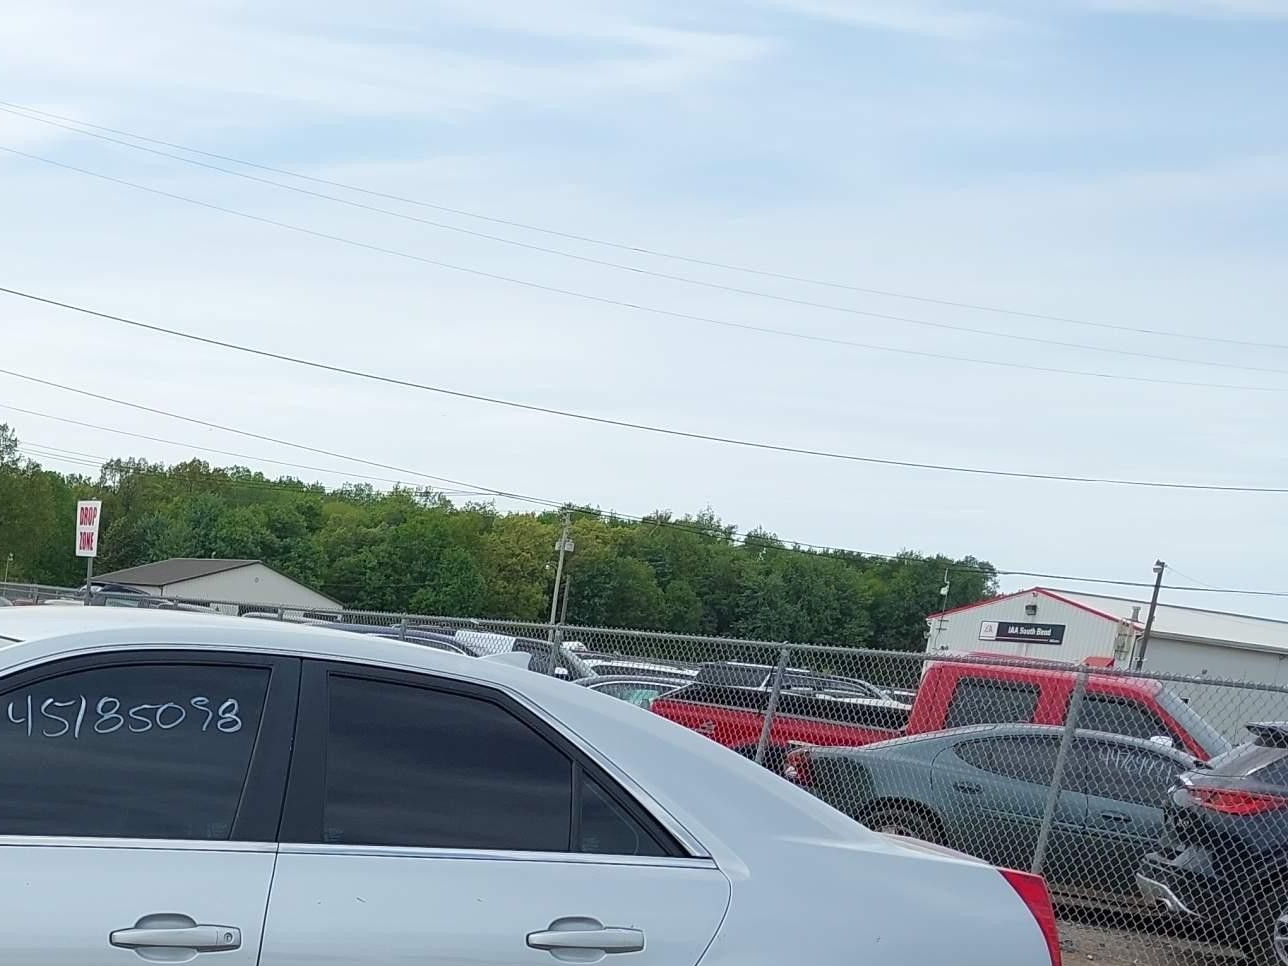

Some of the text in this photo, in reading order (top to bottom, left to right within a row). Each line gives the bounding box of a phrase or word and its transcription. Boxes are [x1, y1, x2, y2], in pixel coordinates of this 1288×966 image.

[80, 506, 97, 526] DROP
[80, 532, 94, 550] ZONE
[1019, 626, 1035, 635] South
[8, 695, 242, 738] 45185098
